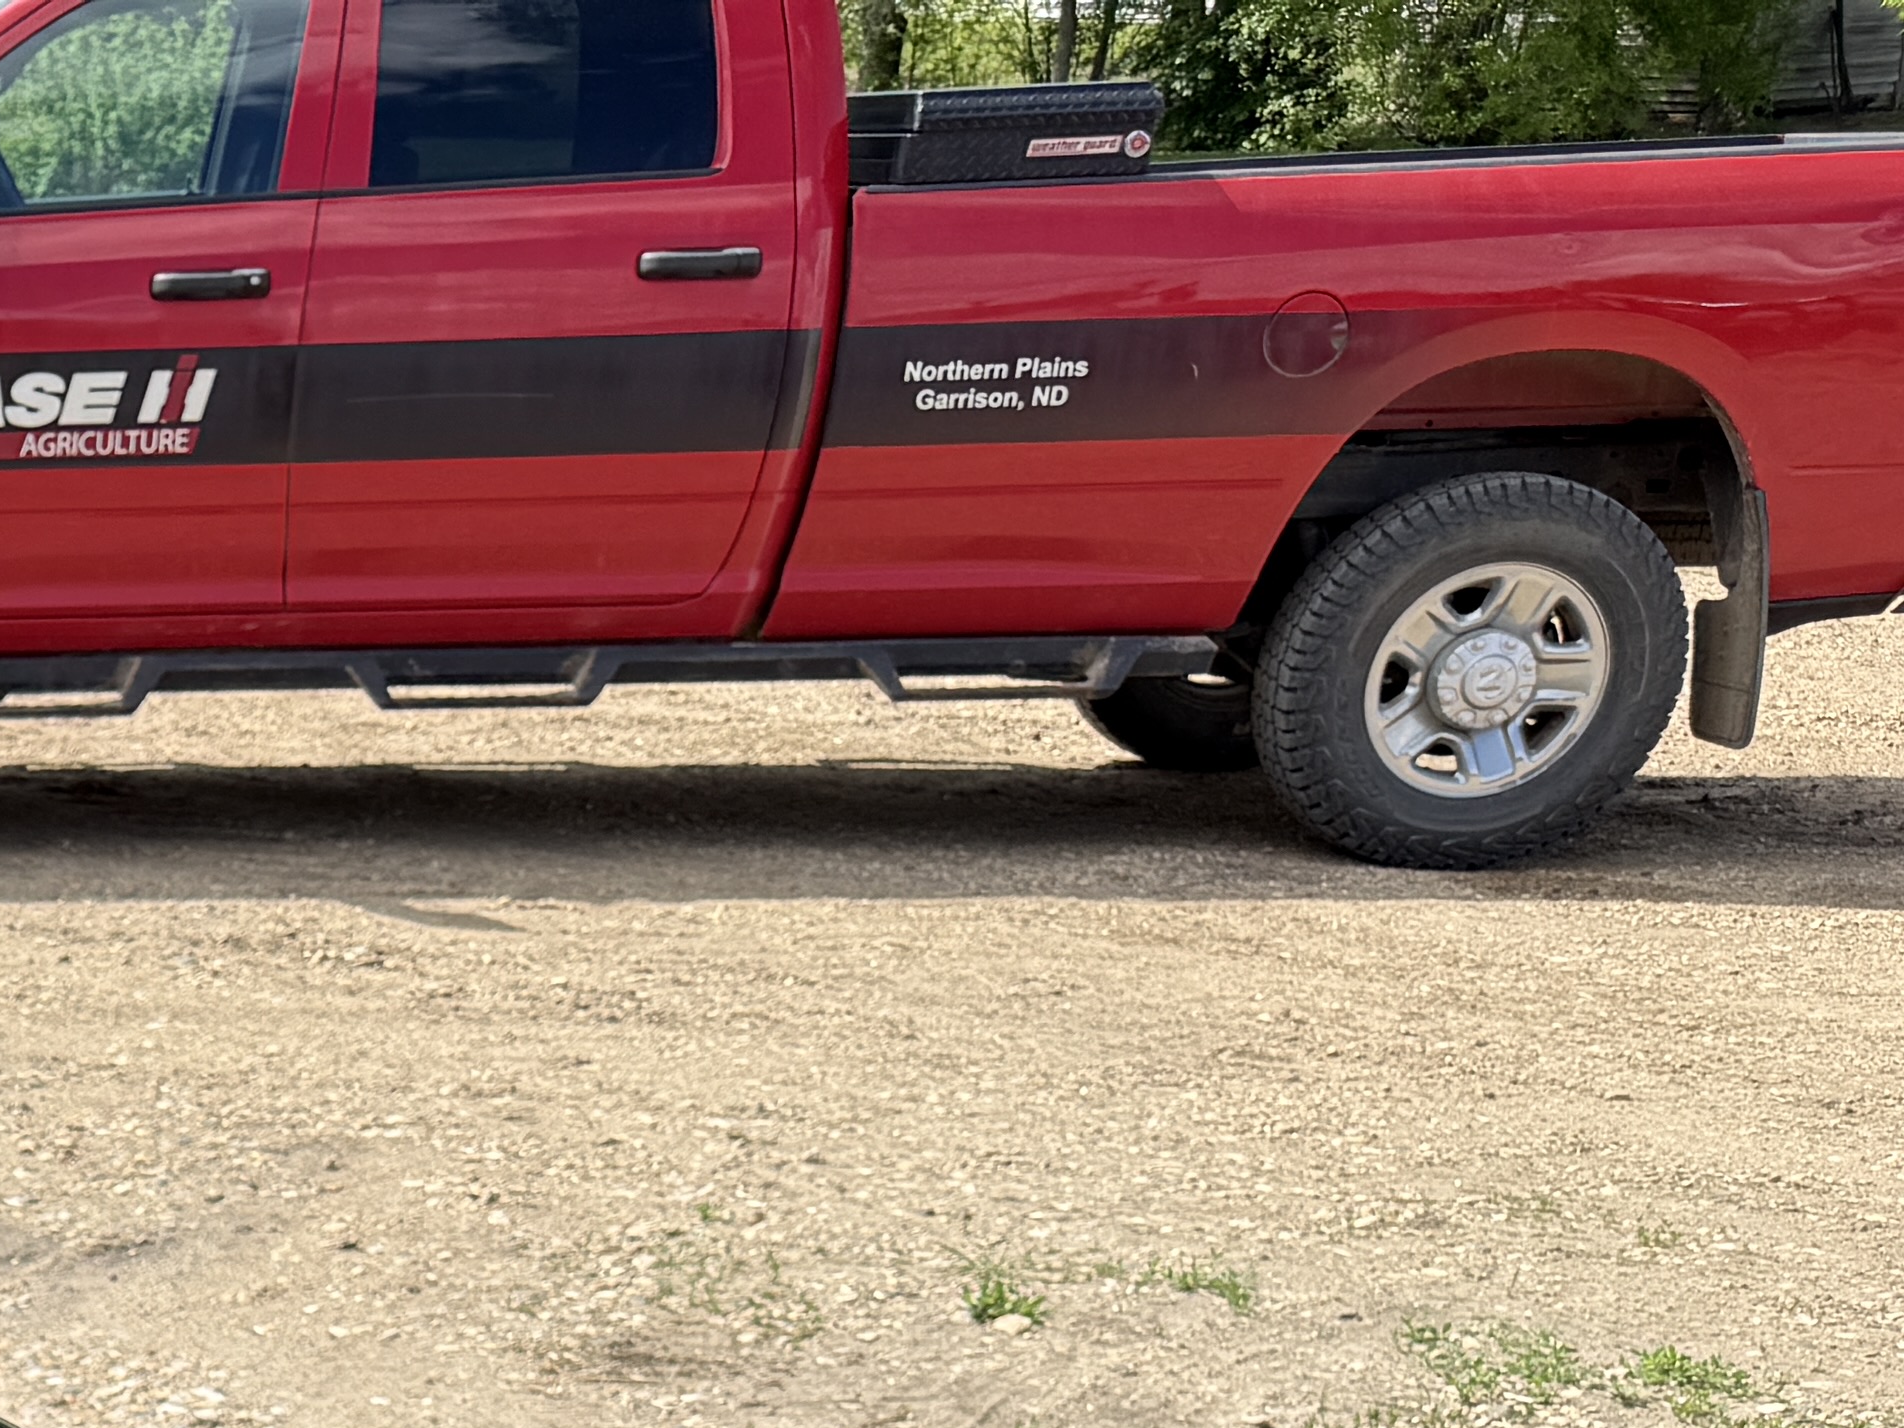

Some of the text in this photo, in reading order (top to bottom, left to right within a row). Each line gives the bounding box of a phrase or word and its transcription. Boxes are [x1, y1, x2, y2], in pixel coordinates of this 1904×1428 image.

[903, 356, 1090, 382] Northern Plains
[915, 385, 1070, 411] Garrison, ND
[19, 427, 191, 459] AGRICULTURE
